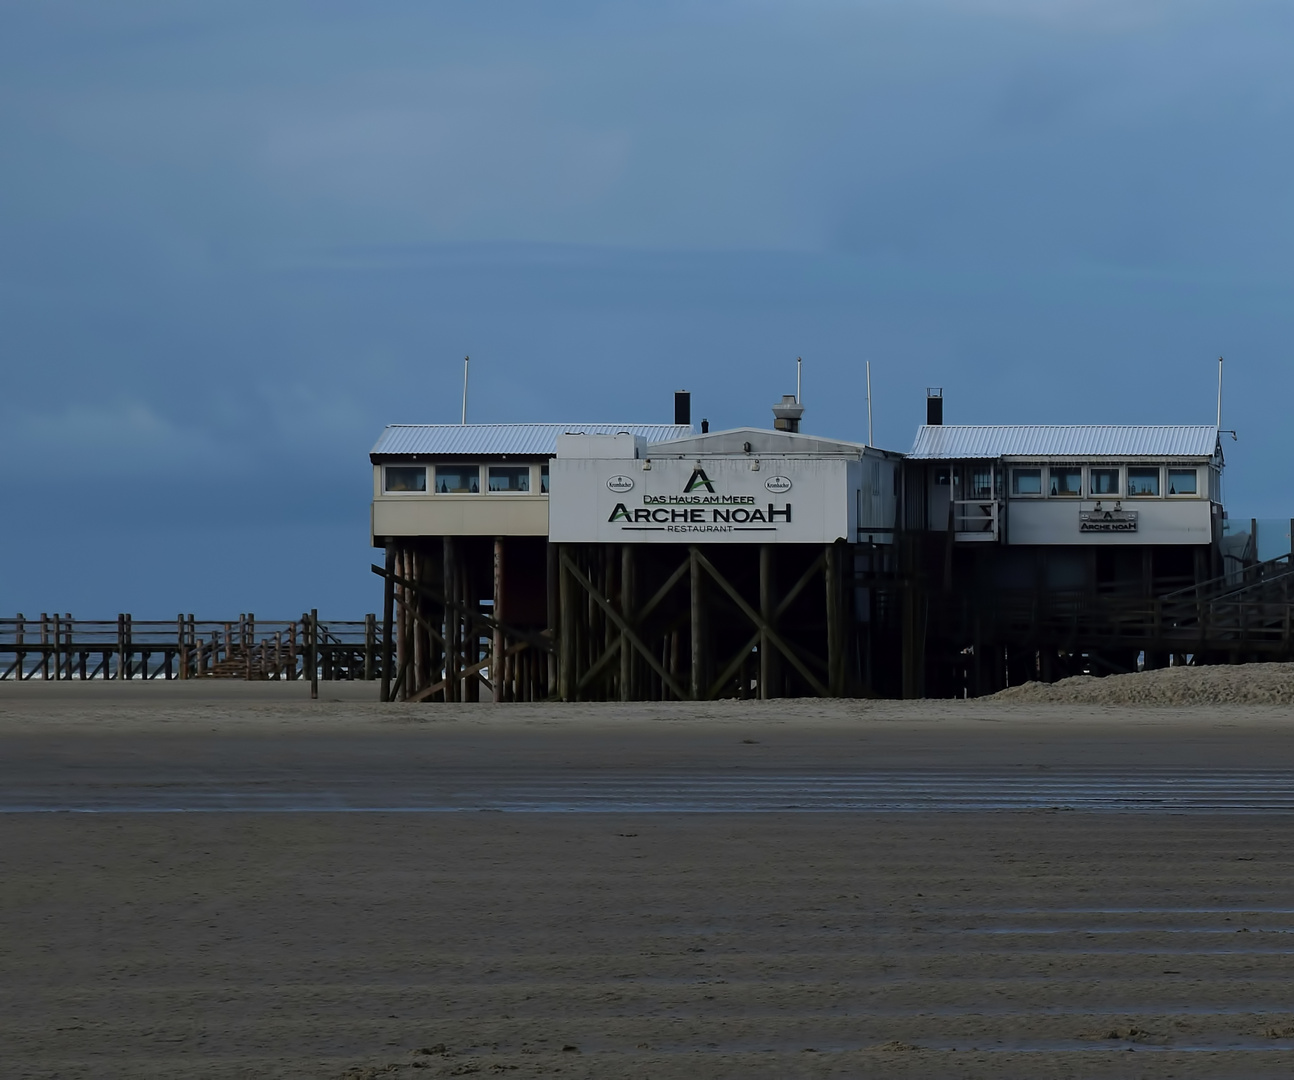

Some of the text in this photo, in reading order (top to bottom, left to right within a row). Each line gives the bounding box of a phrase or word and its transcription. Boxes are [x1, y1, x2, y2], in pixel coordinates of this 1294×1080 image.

[643, 495, 755, 504] DAS HAUS AM MEER
[608, 503, 792, 523] ARCHE NOAH
[667, 525, 733, 533] RESTAURANT
